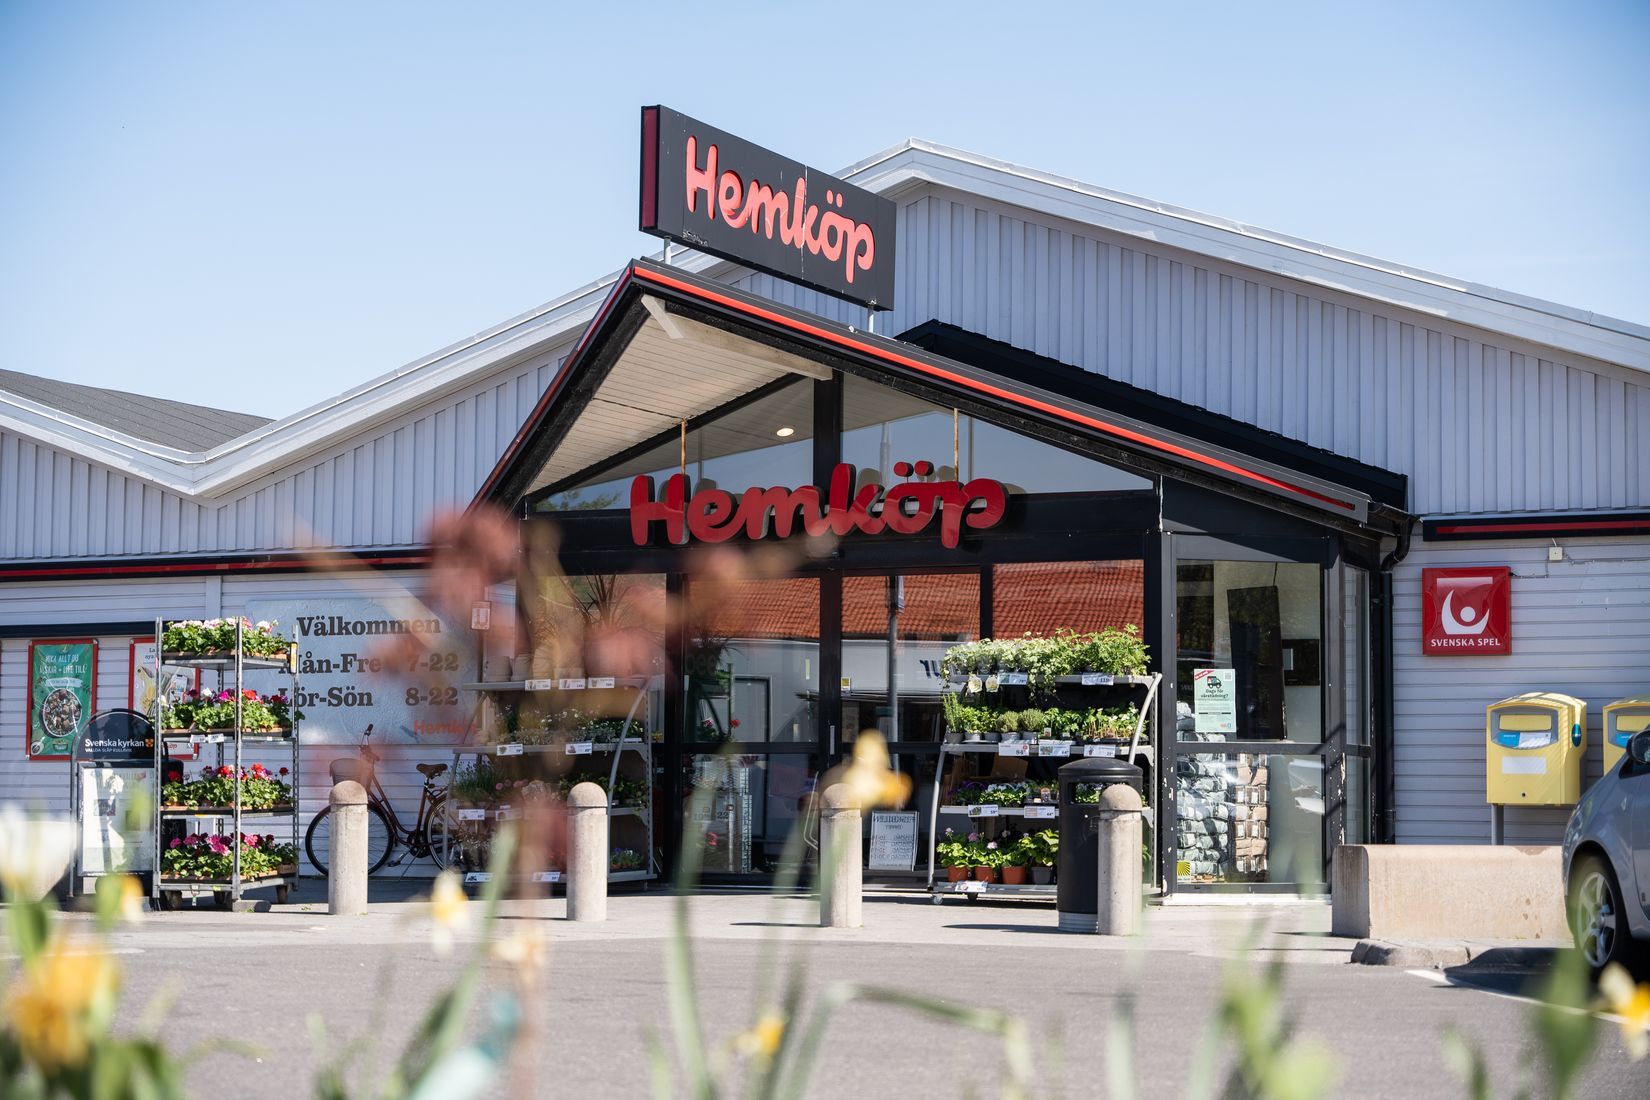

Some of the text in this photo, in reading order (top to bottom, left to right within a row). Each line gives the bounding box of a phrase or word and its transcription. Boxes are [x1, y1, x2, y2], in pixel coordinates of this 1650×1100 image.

[685, 135, 876, 285] Hemköp
[630, 461, 1008, 549] Hemköp
[296, 616, 441, 637] Välkommen
[1431, 638, 1501, 647] SVENSKA SPEL
[407, 653, 460, 673] 7-22
[405, 687, 459, 707] 8-22
[84, 738, 145, 749] Svenska kyrkan
